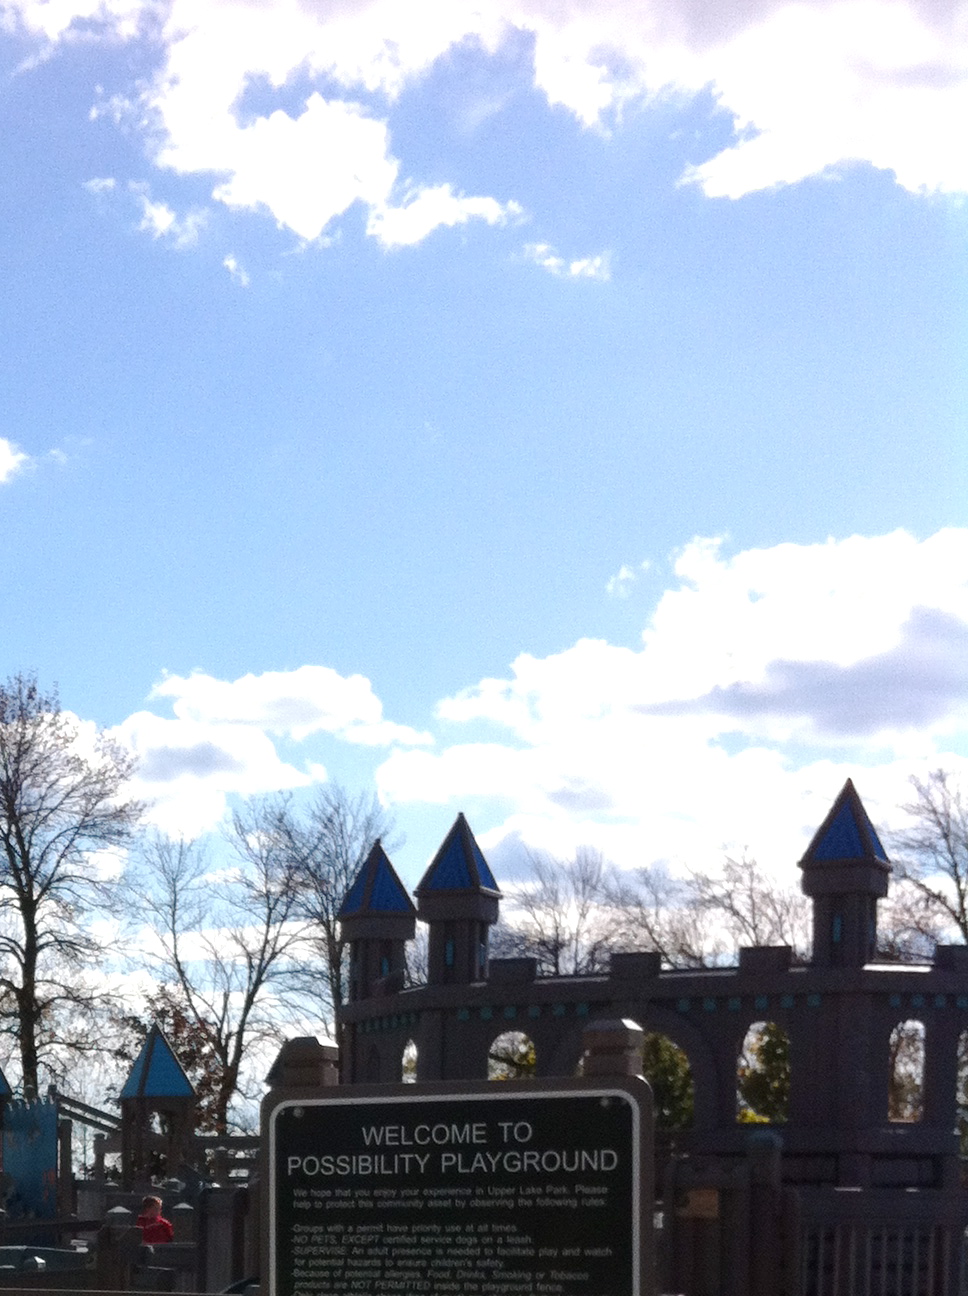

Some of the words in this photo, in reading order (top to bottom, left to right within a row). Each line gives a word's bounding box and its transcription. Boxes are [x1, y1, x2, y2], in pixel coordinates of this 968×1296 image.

[361, 1123, 487, 1145] WELCOME
[498, 1121, 533, 1142] TO
[287, 1153, 431, 1176] POSSIBILITY
[440, 1149, 619, 1173] PLAYGROUND
